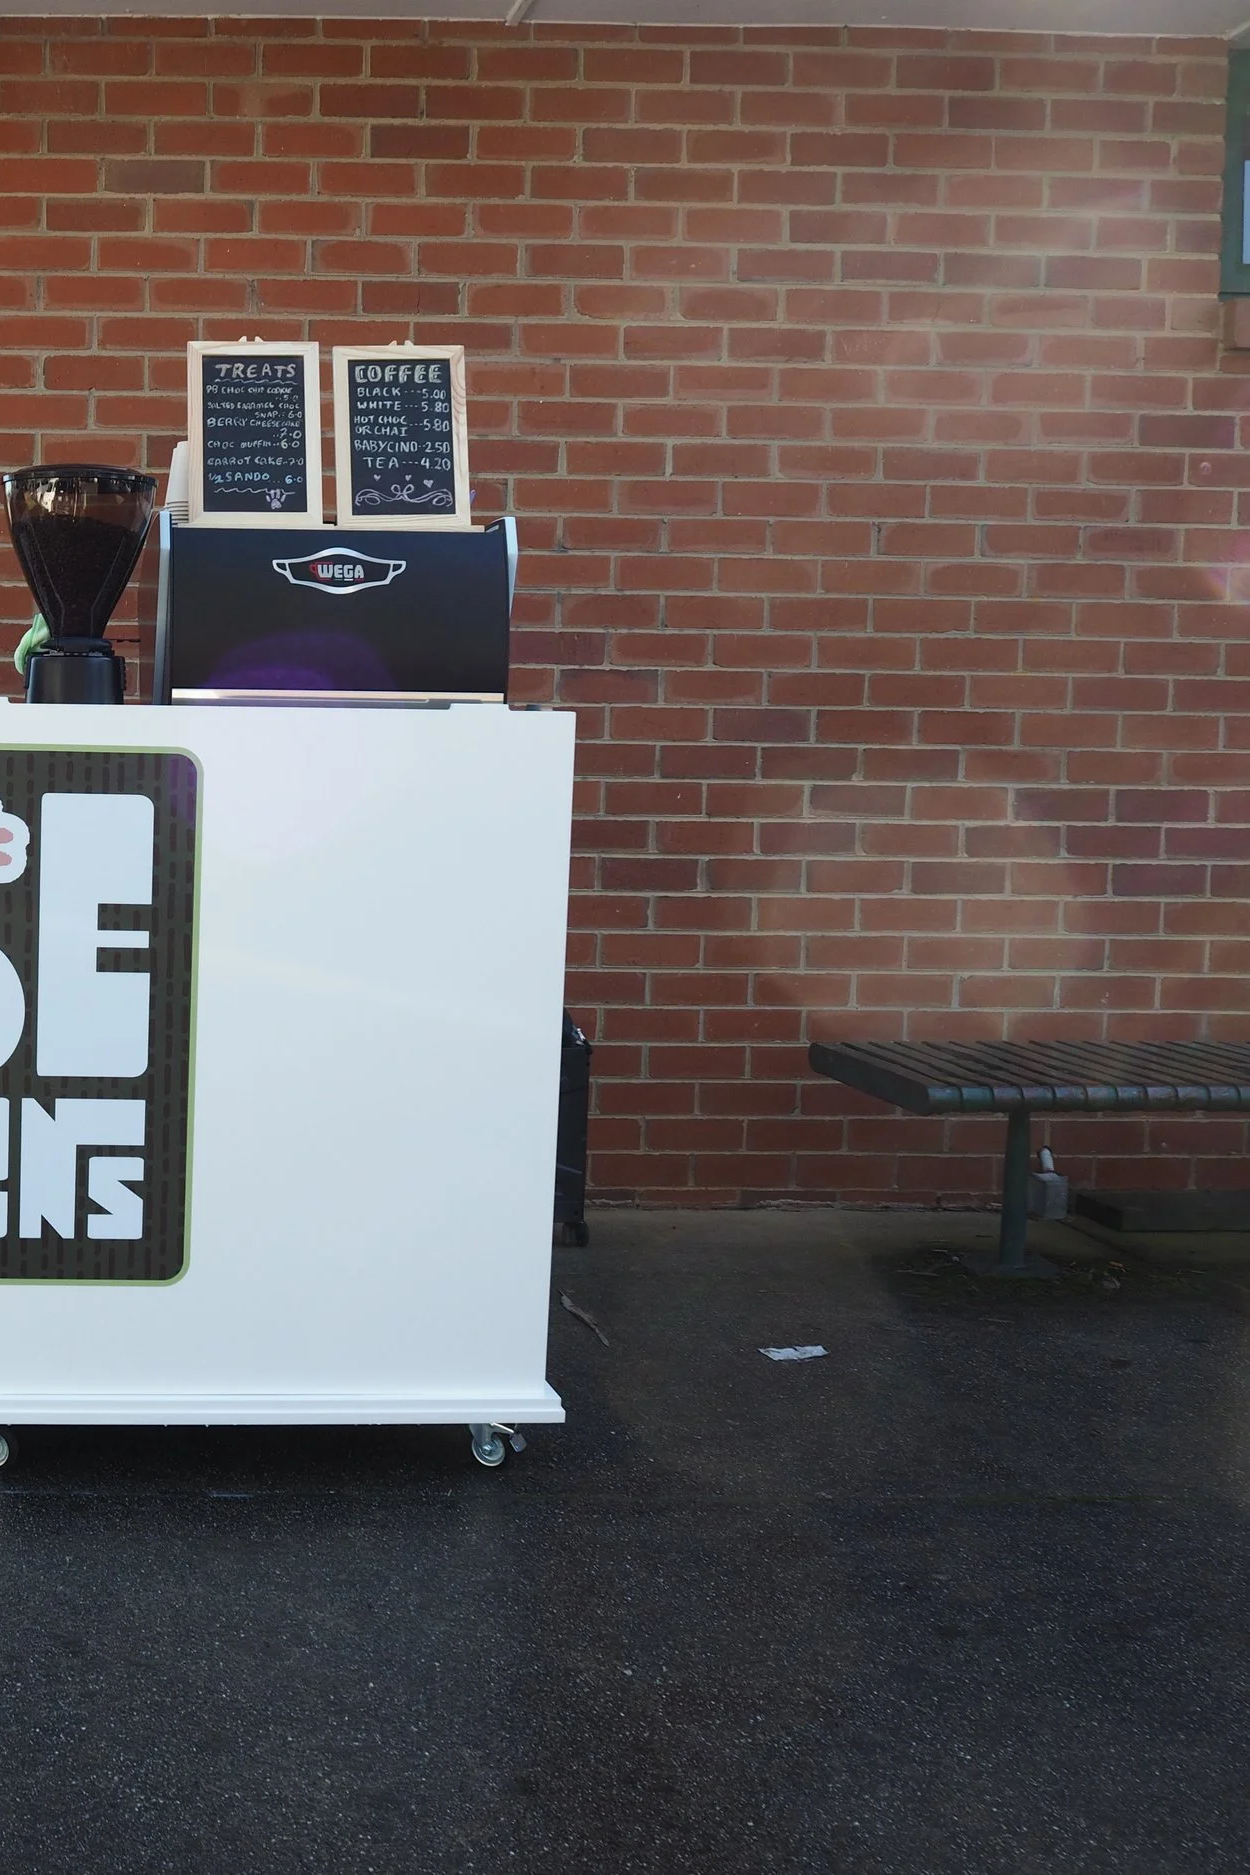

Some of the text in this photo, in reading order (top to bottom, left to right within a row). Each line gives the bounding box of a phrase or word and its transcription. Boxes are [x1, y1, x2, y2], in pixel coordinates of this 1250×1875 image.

[215, 363, 297, 378] TREATS
[354, 364, 442, 384] COFFEE
[206, 385, 218, 394] PB
[221, 386, 245, 394] CHOC
[357, 387, 401, 397] BLACK
[207, 402, 235, 410] SALTED
[237, 402, 275, 410] CARAMEL
[357, 401, 450, 413] WHITE 5.80
[207, 417, 248, 428] BERRY
[354, 415, 374, 424] HOT
[378, 415, 407, 424] CHOC
[355, 426, 408, 437] OR CHAI
[207, 440, 234, 449] CHOC
[354, 440, 418, 453] BABYCINO
[207, 456, 251, 466] CARROT
[254, 456, 283, 466] CAKE
[363, 457, 399, 469] TEA
[225, 471, 270, 481] SANDO
[317, 564, 364, 579] WEGA
